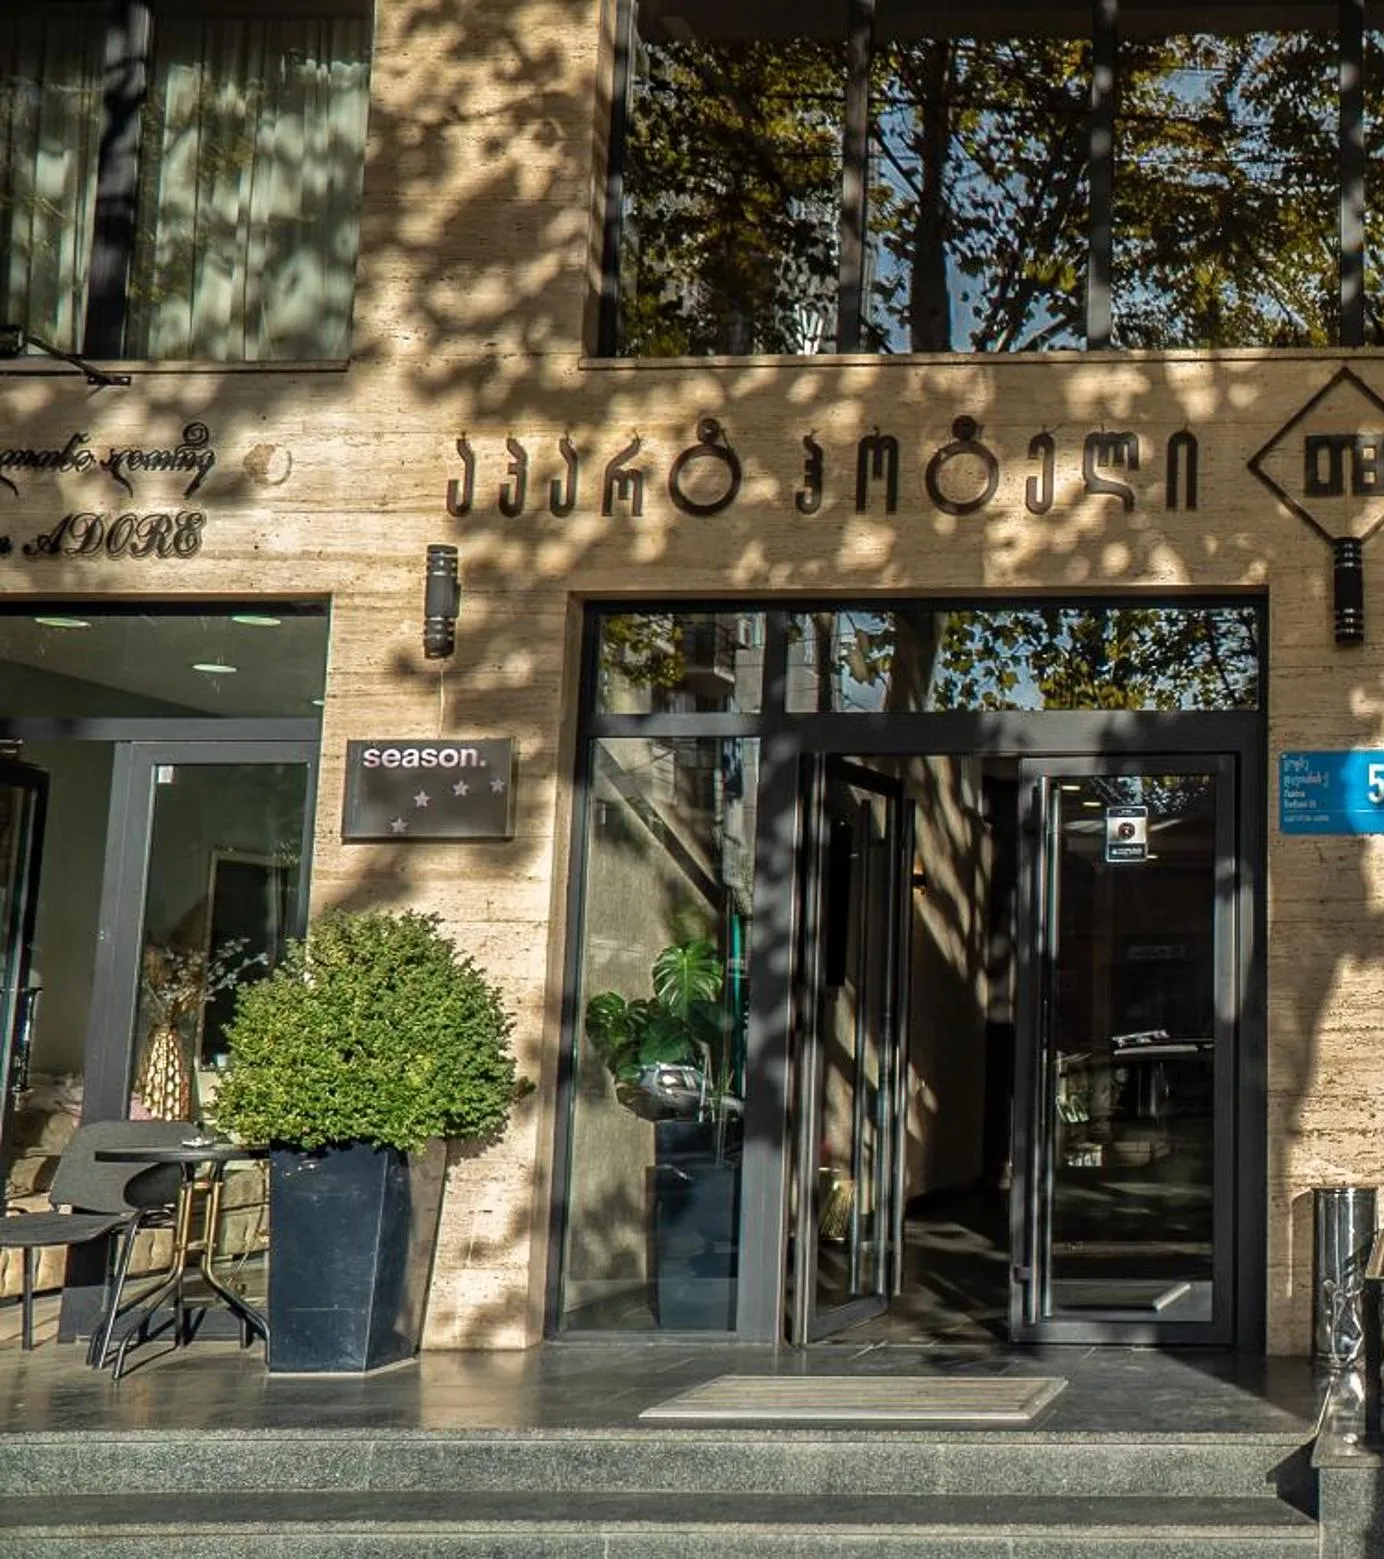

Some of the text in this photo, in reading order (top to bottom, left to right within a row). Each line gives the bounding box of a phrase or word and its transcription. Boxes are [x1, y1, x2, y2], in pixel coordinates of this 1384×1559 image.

[446, 414, 1200, 519] აპარტ ჰოტელი
[22, 510, 208, 559] ADORE
[363, 748, 487, 768] season.
